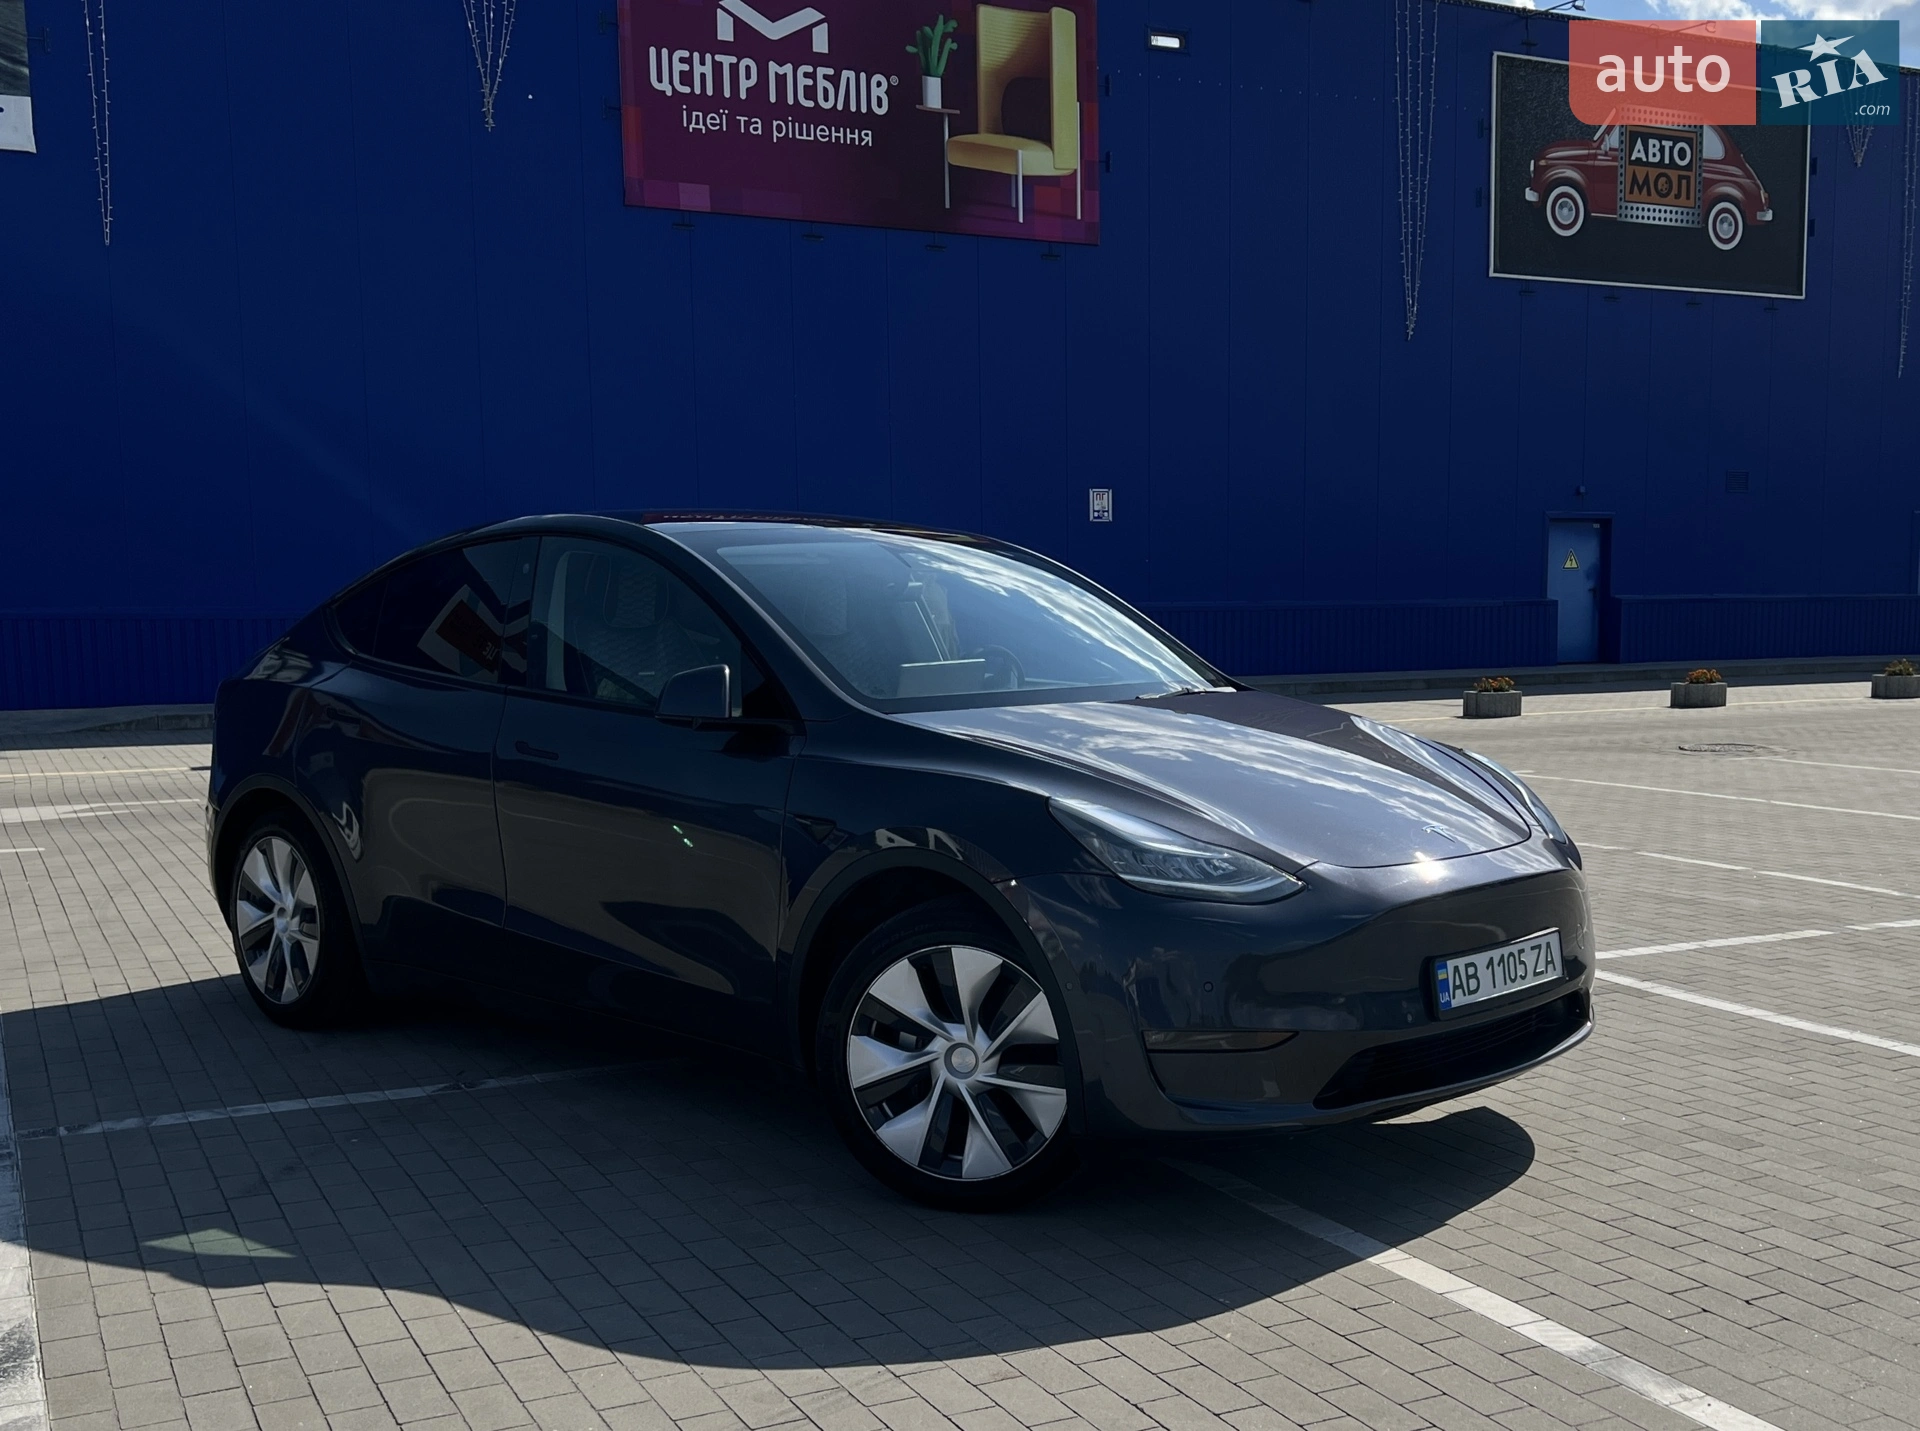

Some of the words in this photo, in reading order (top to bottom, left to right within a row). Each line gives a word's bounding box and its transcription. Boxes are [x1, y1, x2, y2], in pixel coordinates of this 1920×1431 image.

[649, 46, 758, 100] ЦЕНТР
[682, 104, 729, 134] ідеї
[736, 115, 762, 135] та
[772, 116, 873, 147] рішення
[1630, 136, 1692, 167] АВТО
[1628, 169, 1692, 201] МОЛ
[1452, 961, 1481, 1000] AB
[1486, 948, 1528, 989] 1105
[1530, 941, 1556, 977] ZA
[1439, 991, 1450, 1004] UA
